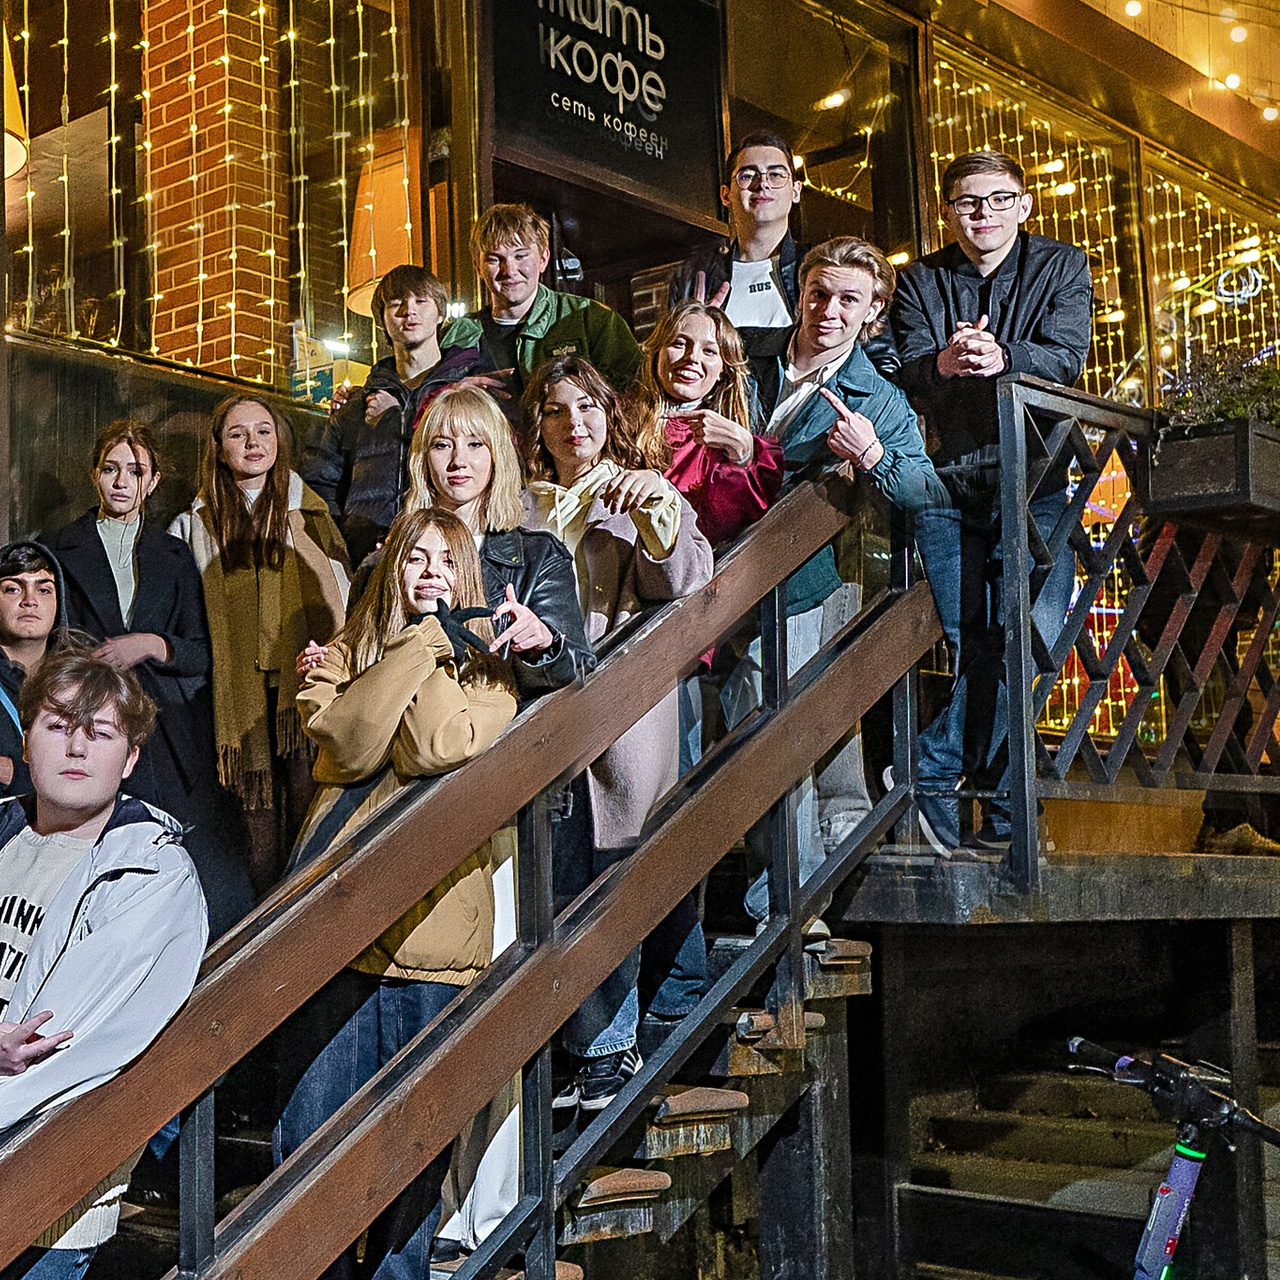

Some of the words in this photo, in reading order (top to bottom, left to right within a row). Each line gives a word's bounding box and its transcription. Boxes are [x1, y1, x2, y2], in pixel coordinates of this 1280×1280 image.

[549, 26, 667, 115] кофе
[550, 92, 596, 122] сеть
[603, 112, 668, 154] кофеен
